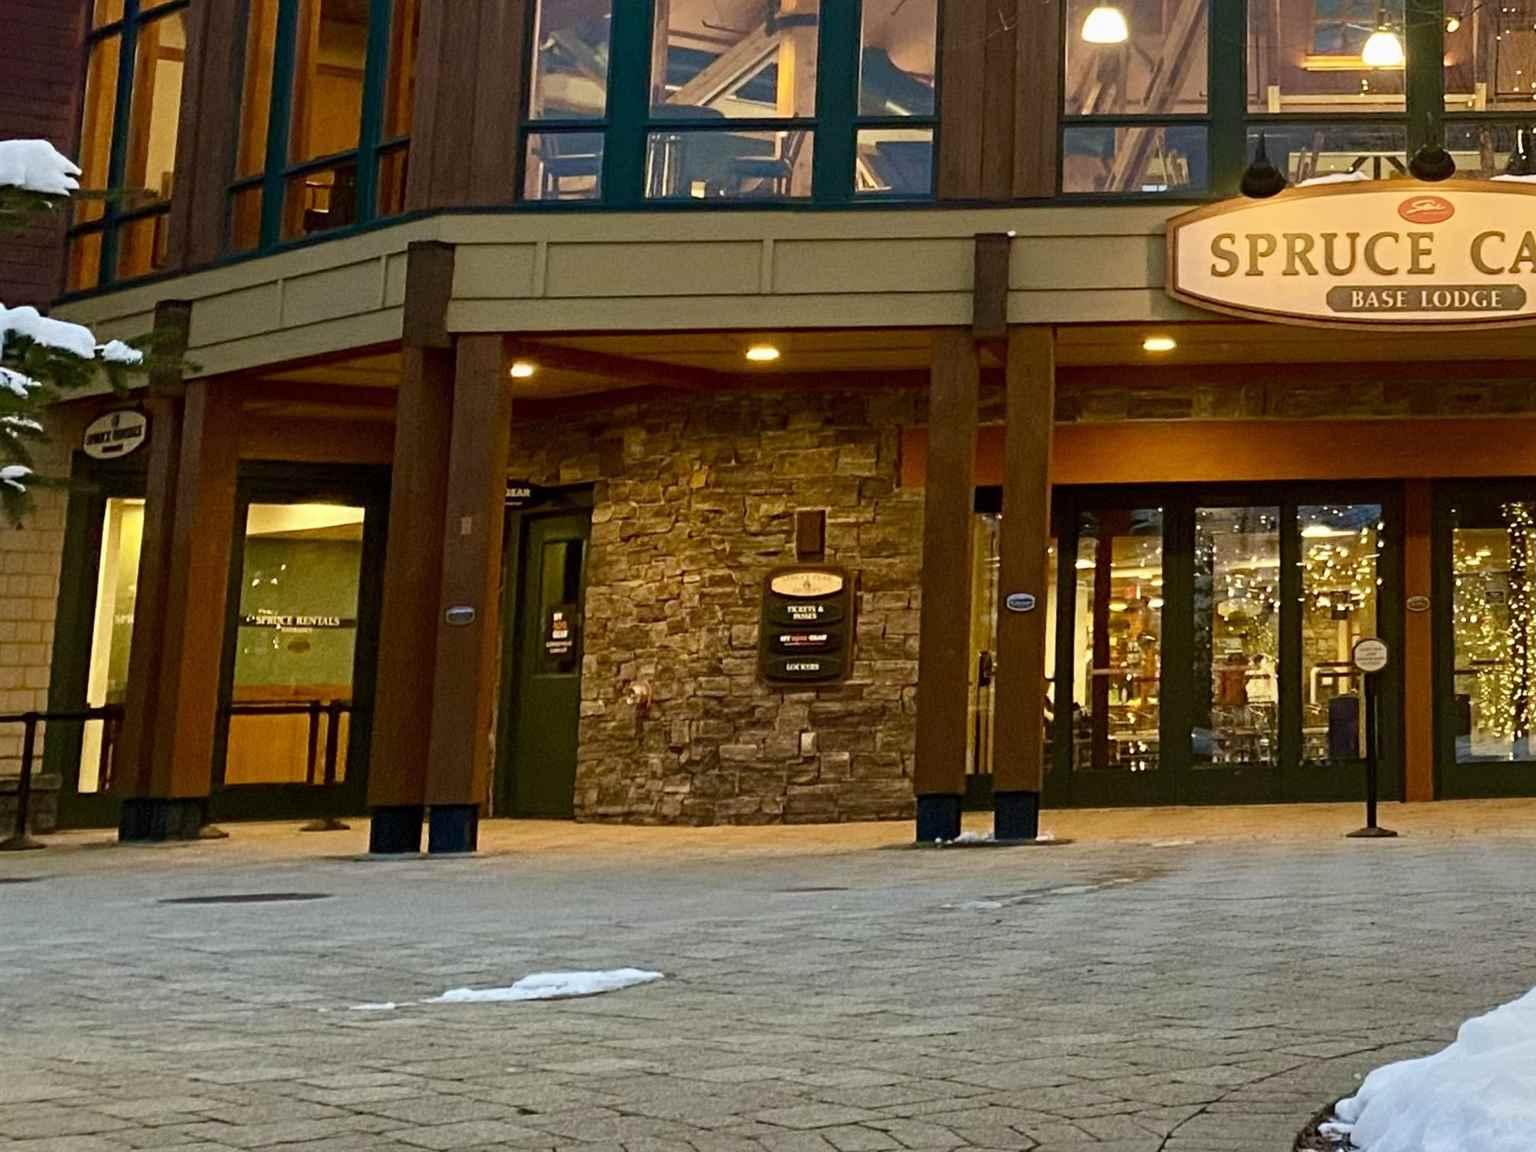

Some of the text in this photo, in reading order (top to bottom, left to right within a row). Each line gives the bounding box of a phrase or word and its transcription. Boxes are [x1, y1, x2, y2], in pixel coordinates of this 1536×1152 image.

[1209, 231, 1436, 278] SPRUCE
[1350, 288, 1503, 309] BASE LODGE
[255, 615, 340, 626] SPRUCE RENTALS
